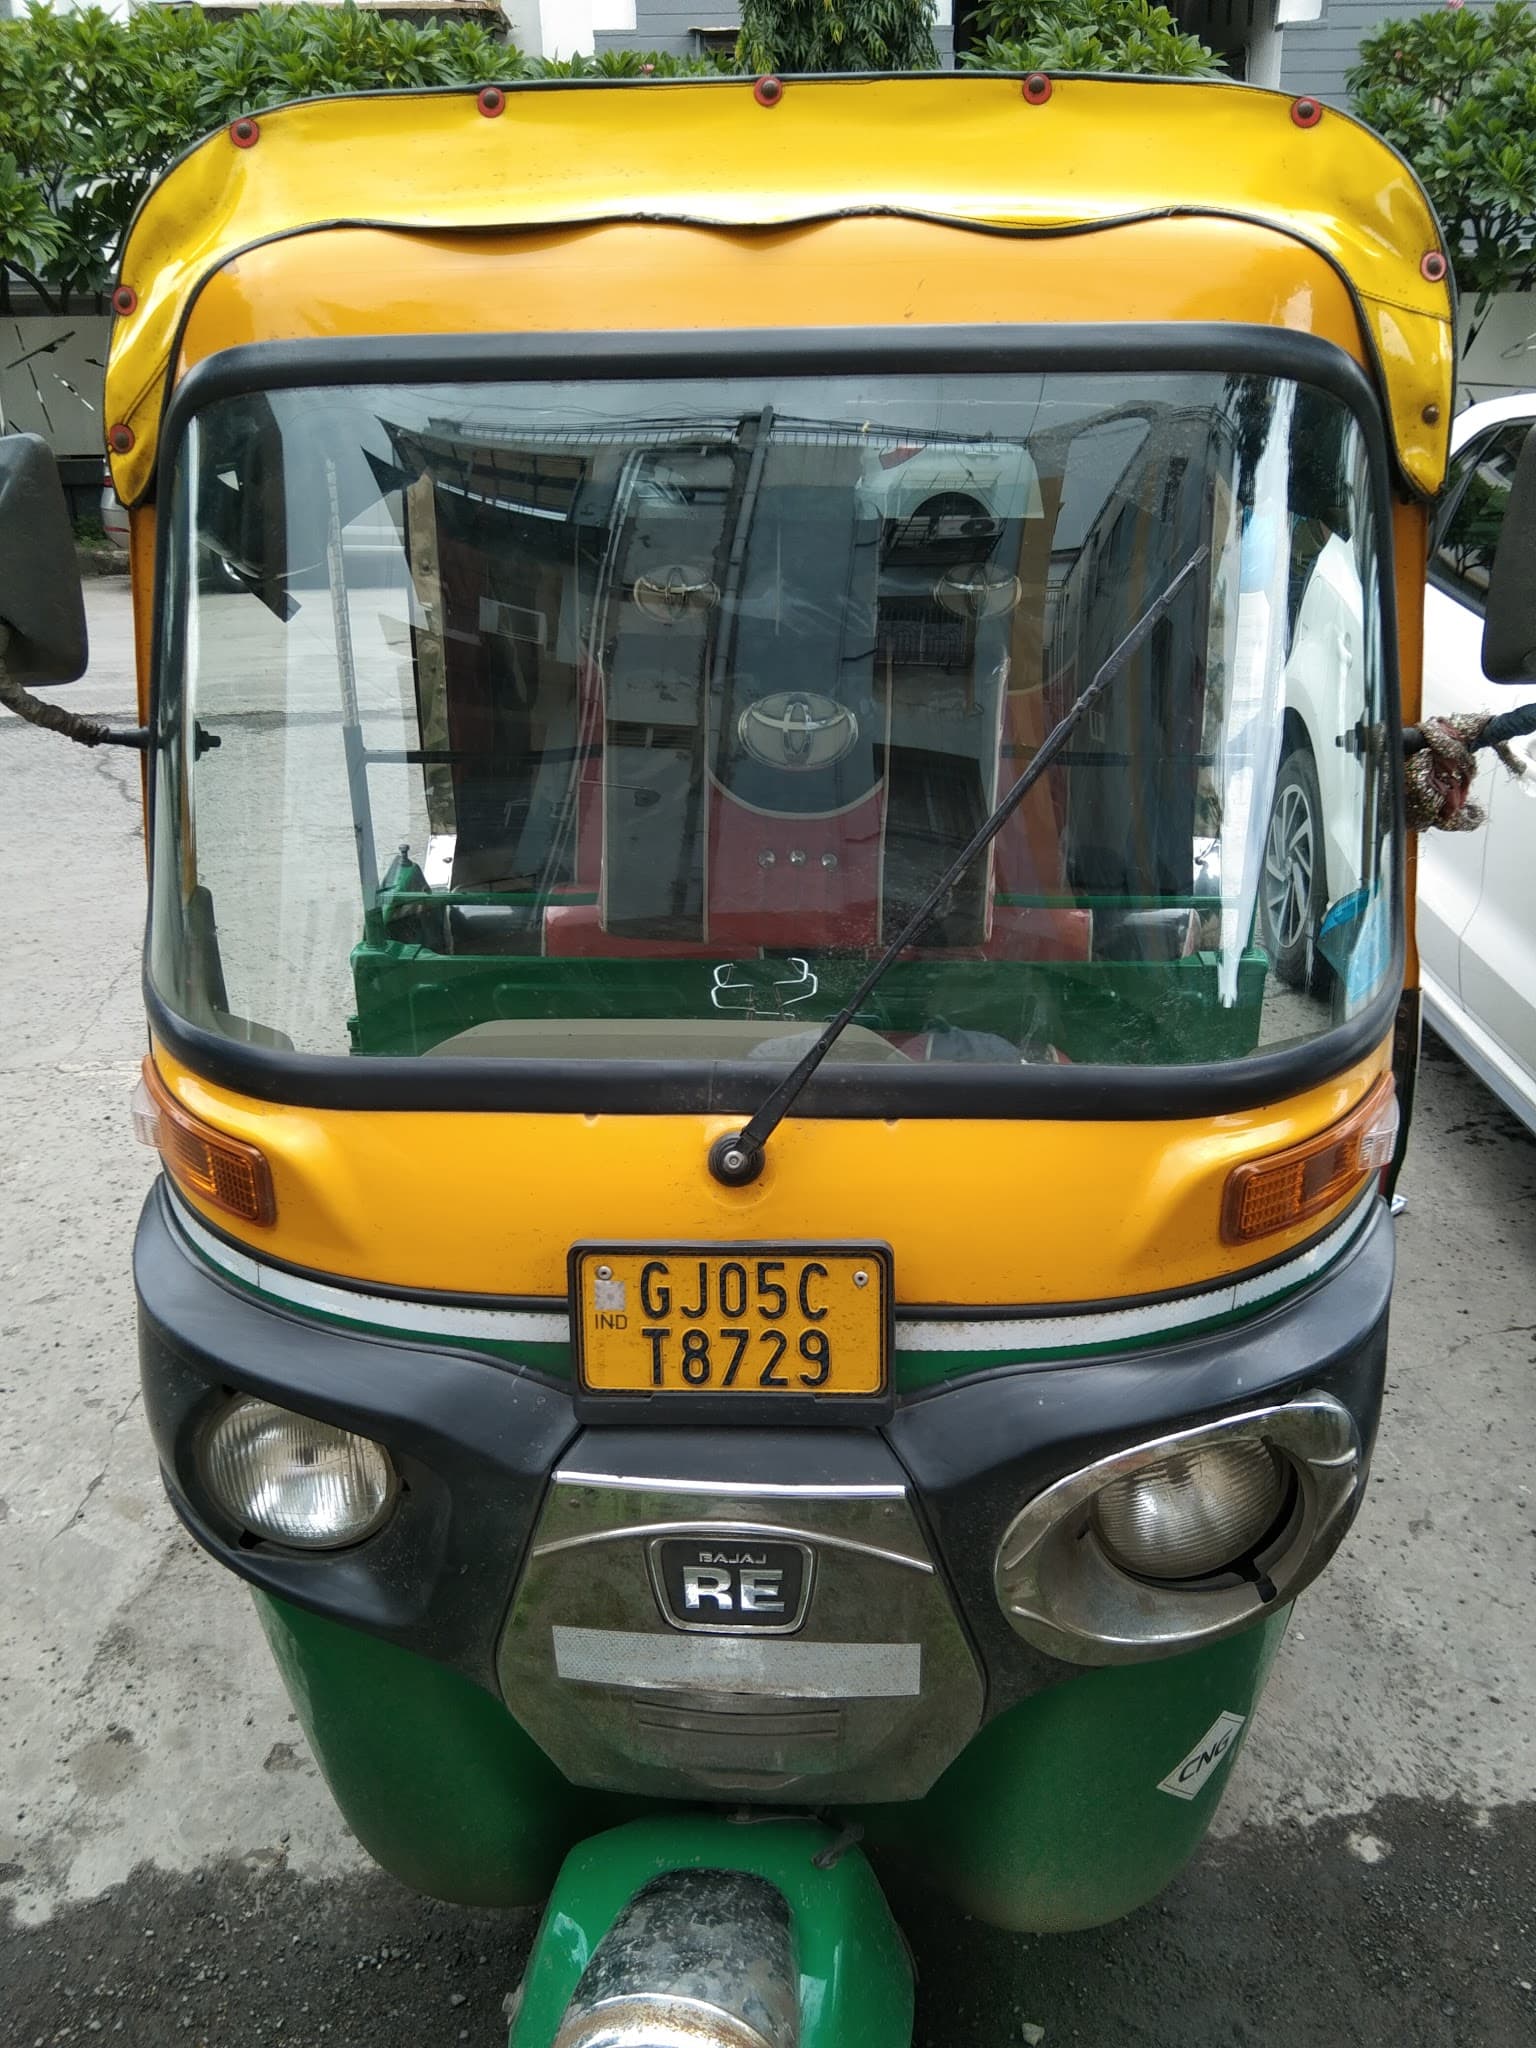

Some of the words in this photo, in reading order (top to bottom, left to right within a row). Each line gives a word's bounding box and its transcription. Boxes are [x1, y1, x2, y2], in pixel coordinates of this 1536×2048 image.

[641, 1262, 829, 1321] GJ05C
[595, 1313, 628, 1330] IND
[641, 1328, 830, 1387] T8729
[699, 1552, 767, 1565] BAJAJ
[683, 1566, 785, 1612] RE
[1178, 1727, 1233, 1783] CNG
